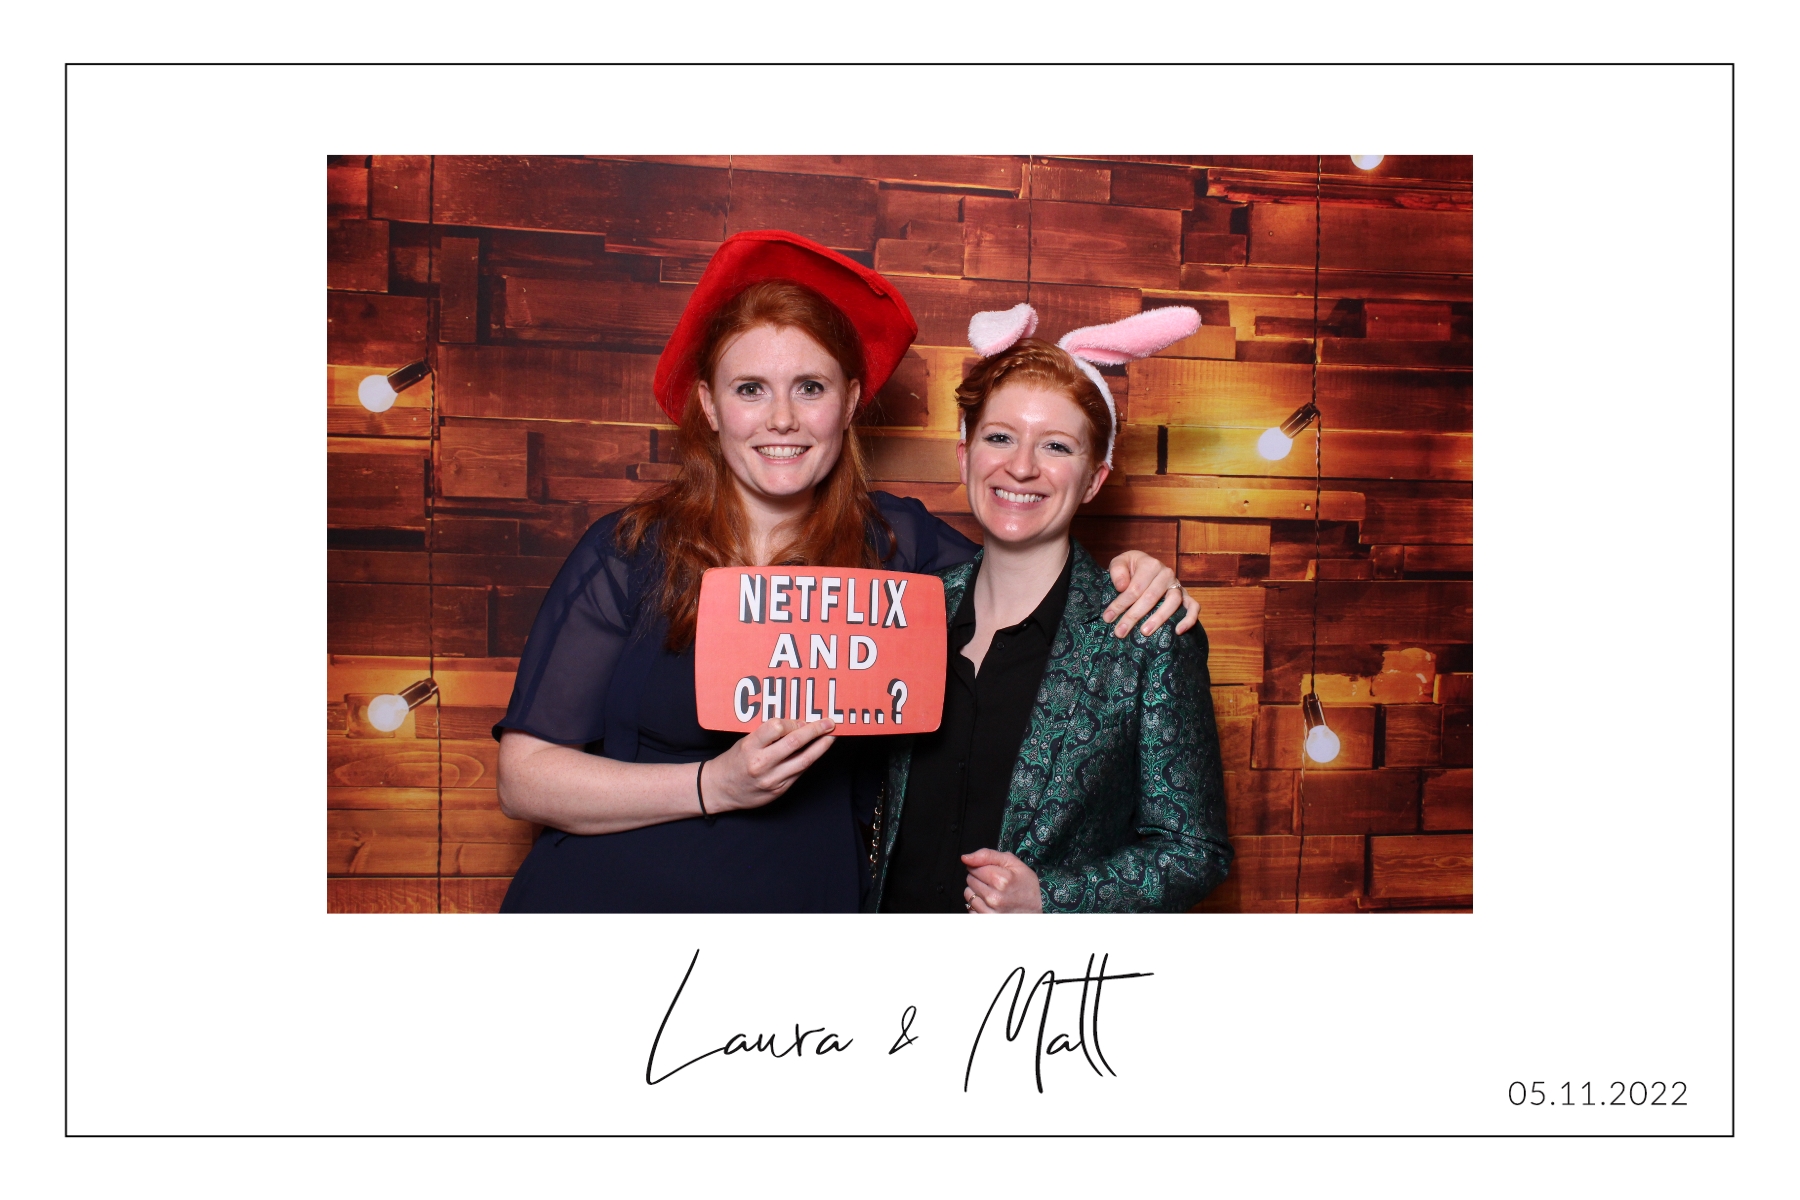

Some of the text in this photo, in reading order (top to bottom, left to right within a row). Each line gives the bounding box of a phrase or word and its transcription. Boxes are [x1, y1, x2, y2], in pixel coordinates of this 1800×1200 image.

[738, 573, 908, 628] NETFLIX
[768, 633, 878, 670] AND
[734, 675, 909, 724] CHILL...?
